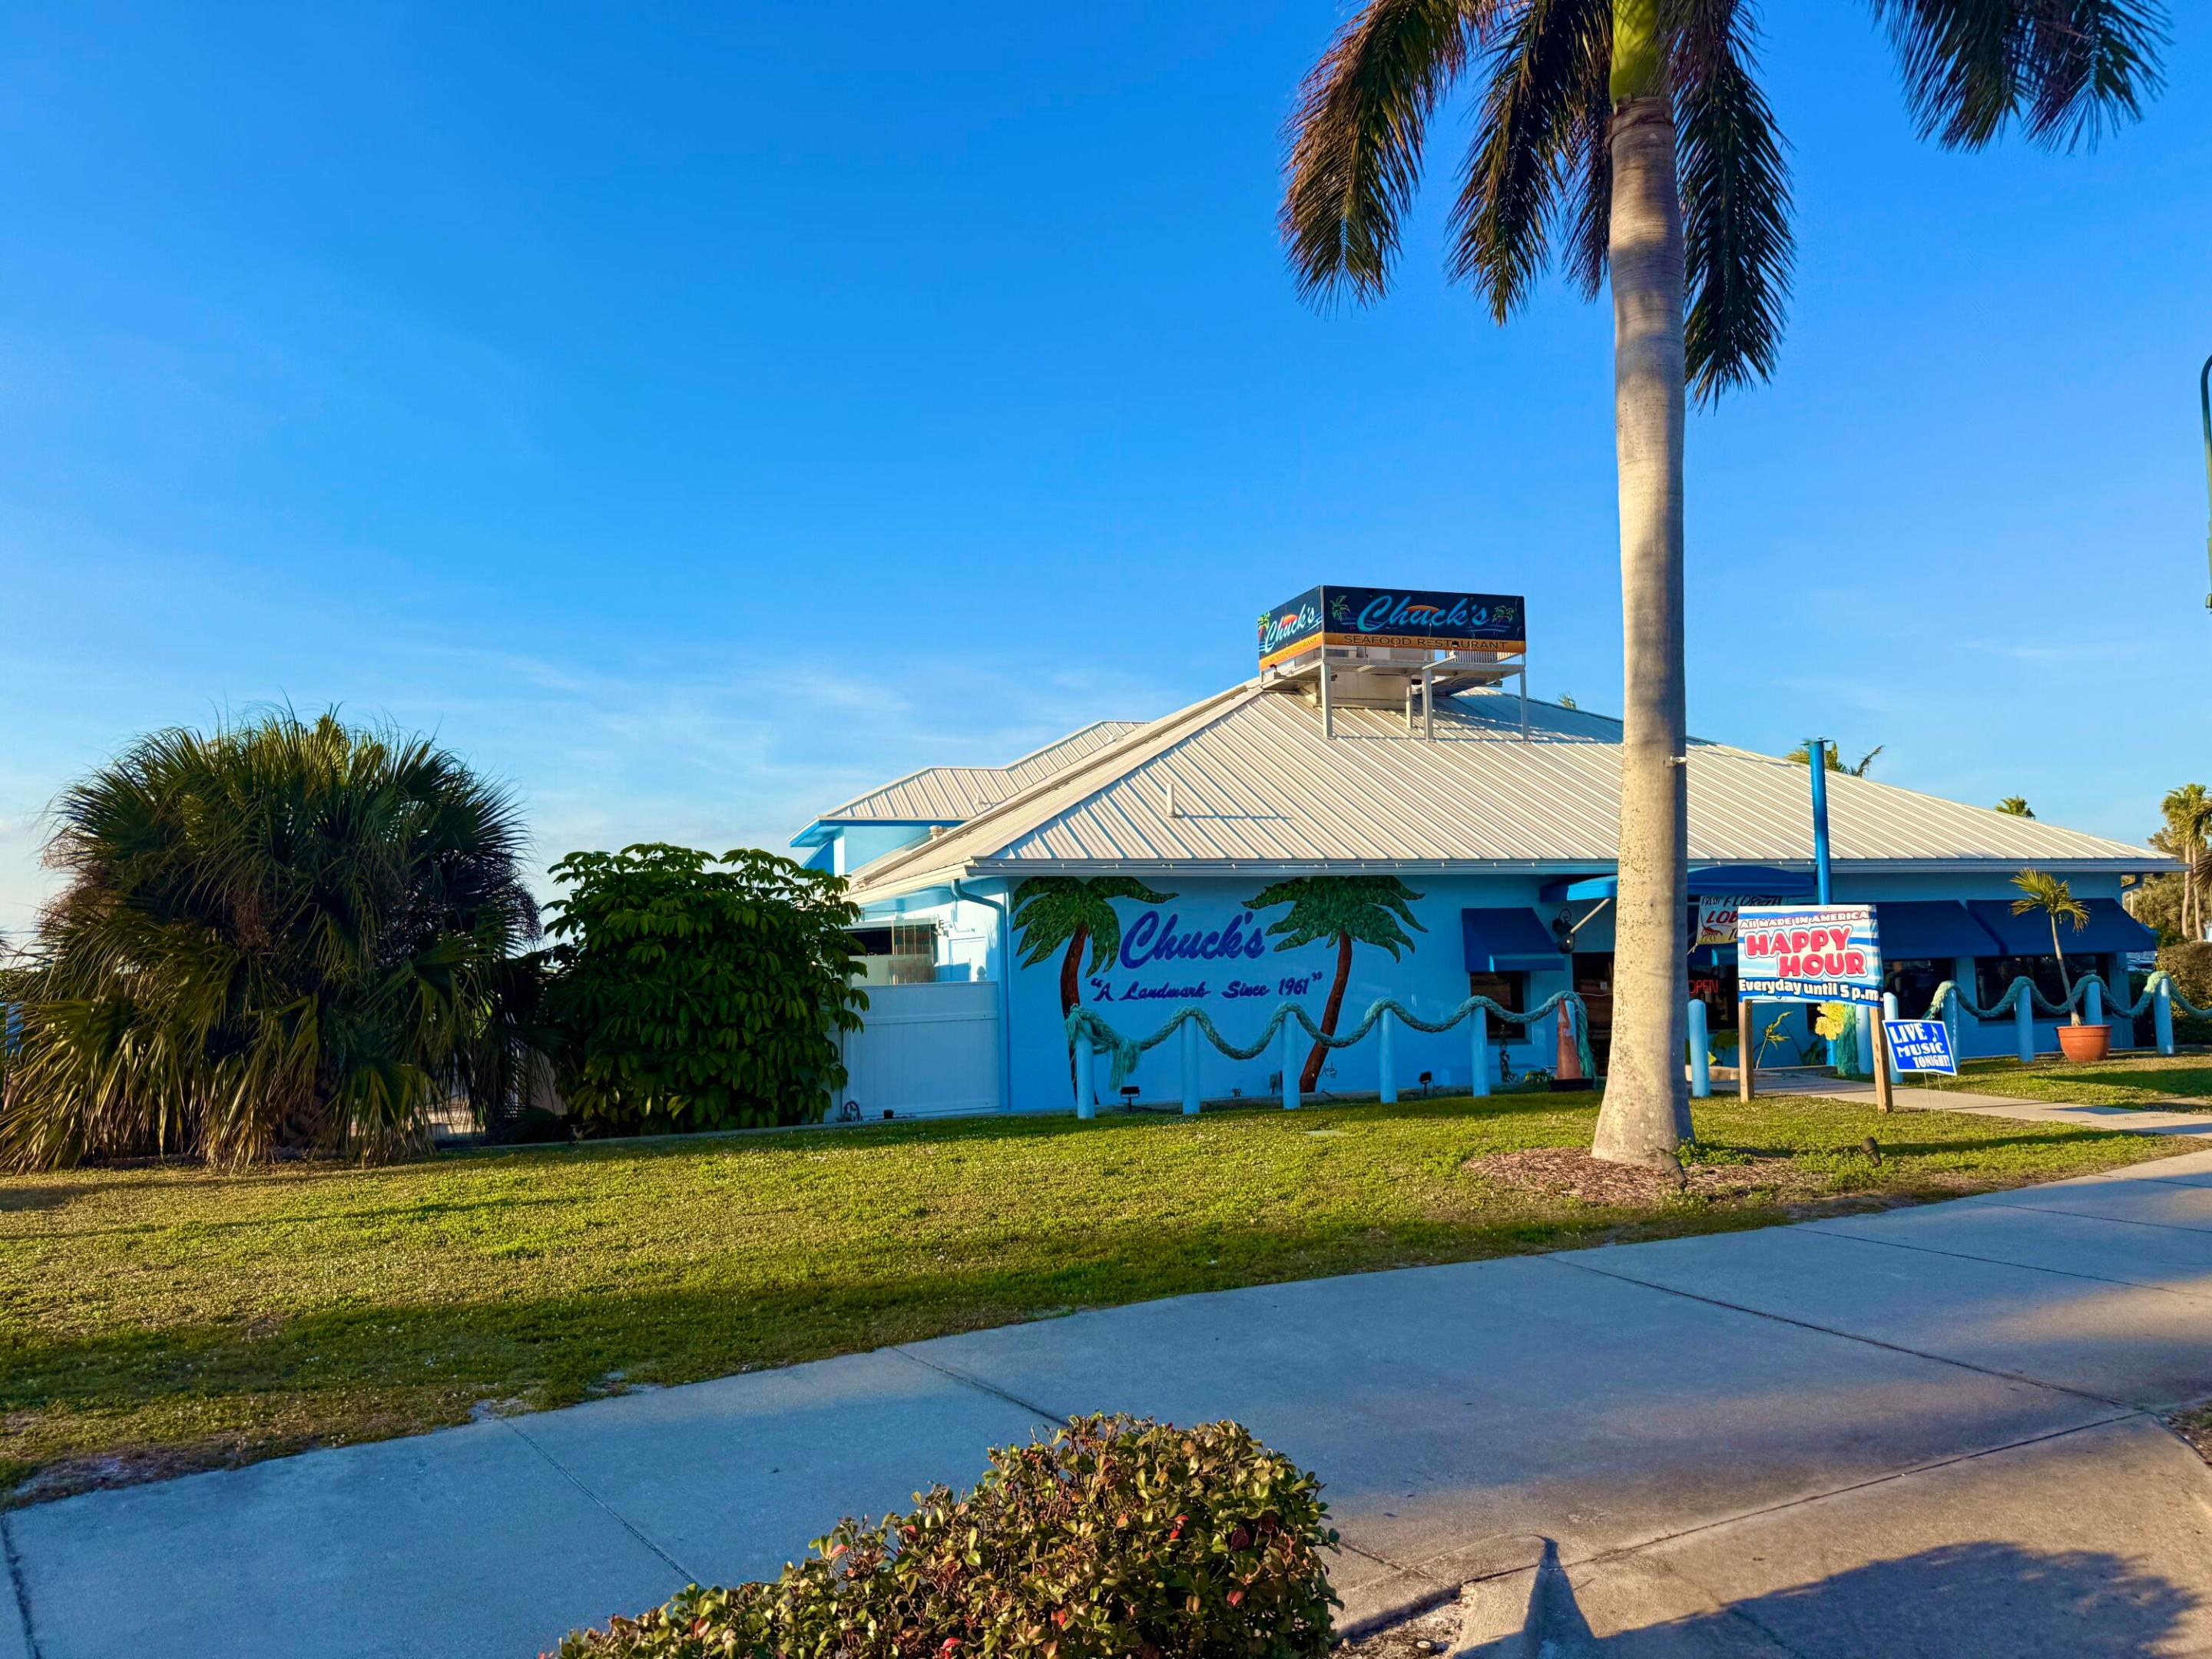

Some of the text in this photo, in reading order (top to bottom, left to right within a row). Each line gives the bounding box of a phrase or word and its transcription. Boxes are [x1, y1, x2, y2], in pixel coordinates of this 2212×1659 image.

[1356, 595, 1489, 632] Chuck's
[1264, 603, 1316, 653] Chuck's
[1344, 634, 1412, 647] SEAFOOD
[1759, 917, 1793, 928] MADE
[1794, 916, 1810, 926] IN
[1810, 910, 1869, 924] AMERICA
[1120, 910, 1266, 969] Chuck's
[1745, 927, 1852, 957] HAPPY
[1778, 951, 1866, 978] HOUR
[1118, 980, 1211, 1001] Landmark
[1221, 979, 1271, 999] Since
[1688, 979, 1720, 995] OPEN
[1738, 979, 1884, 1002] Everyday until 5 p.m.
[1887, 1022, 1929, 1045] LIVE
[1896, 1042, 1945, 1058] MUSIC
